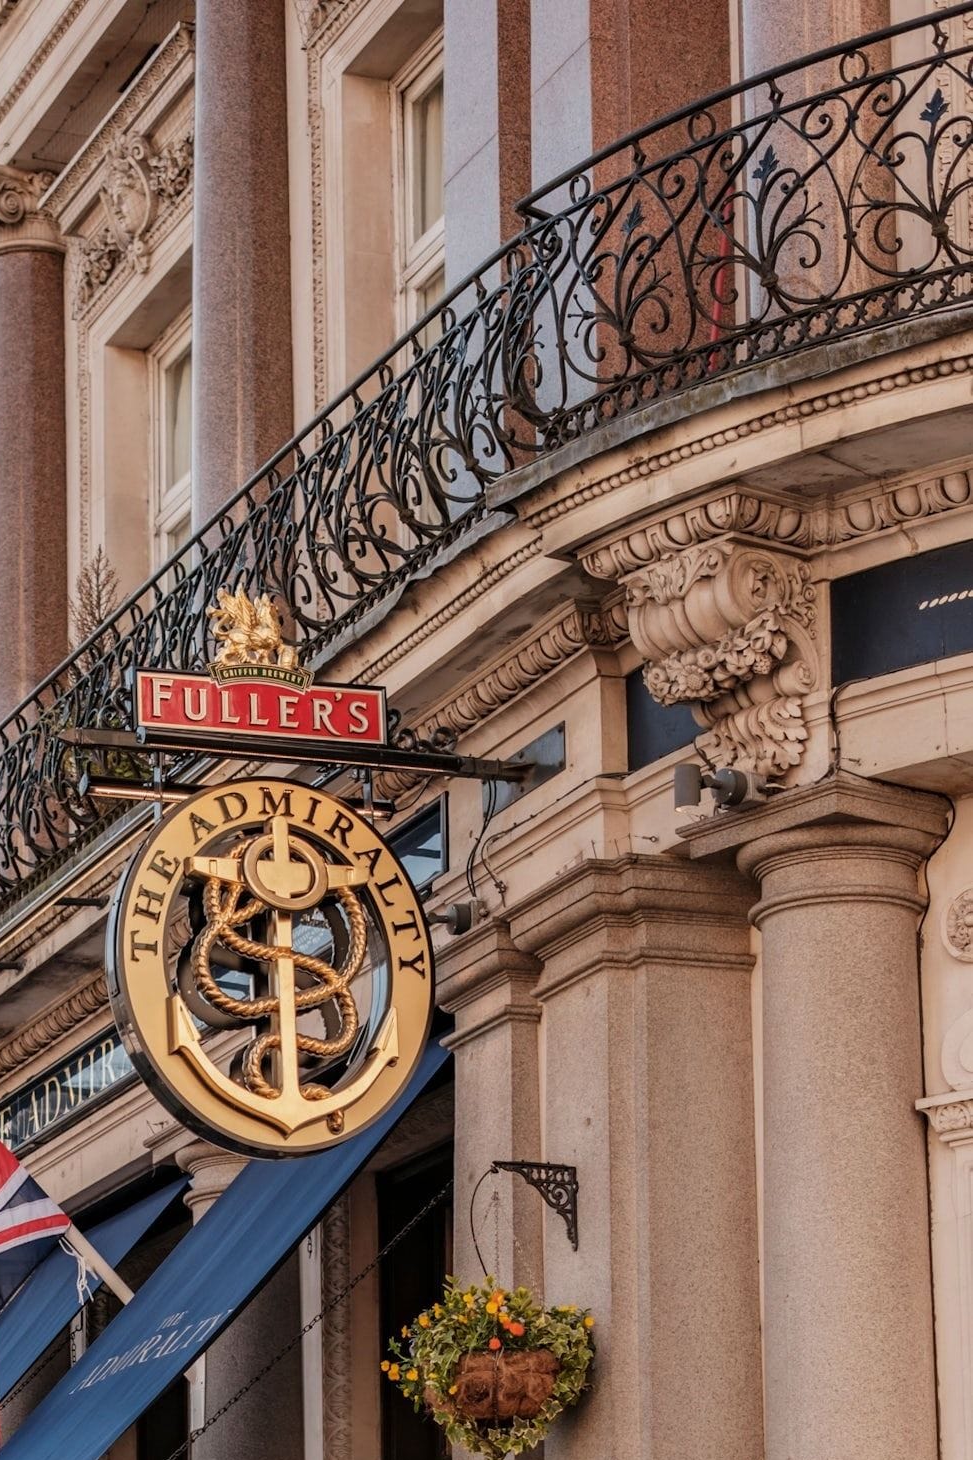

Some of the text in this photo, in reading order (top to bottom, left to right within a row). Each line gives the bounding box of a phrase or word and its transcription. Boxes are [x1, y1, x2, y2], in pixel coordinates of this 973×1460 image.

[223, 667, 303, 684] GRIFFIN BREWERY
[151, 678, 369, 736] FULLER'S
[130, 786, 426, 980] THE ADMIRALTY
